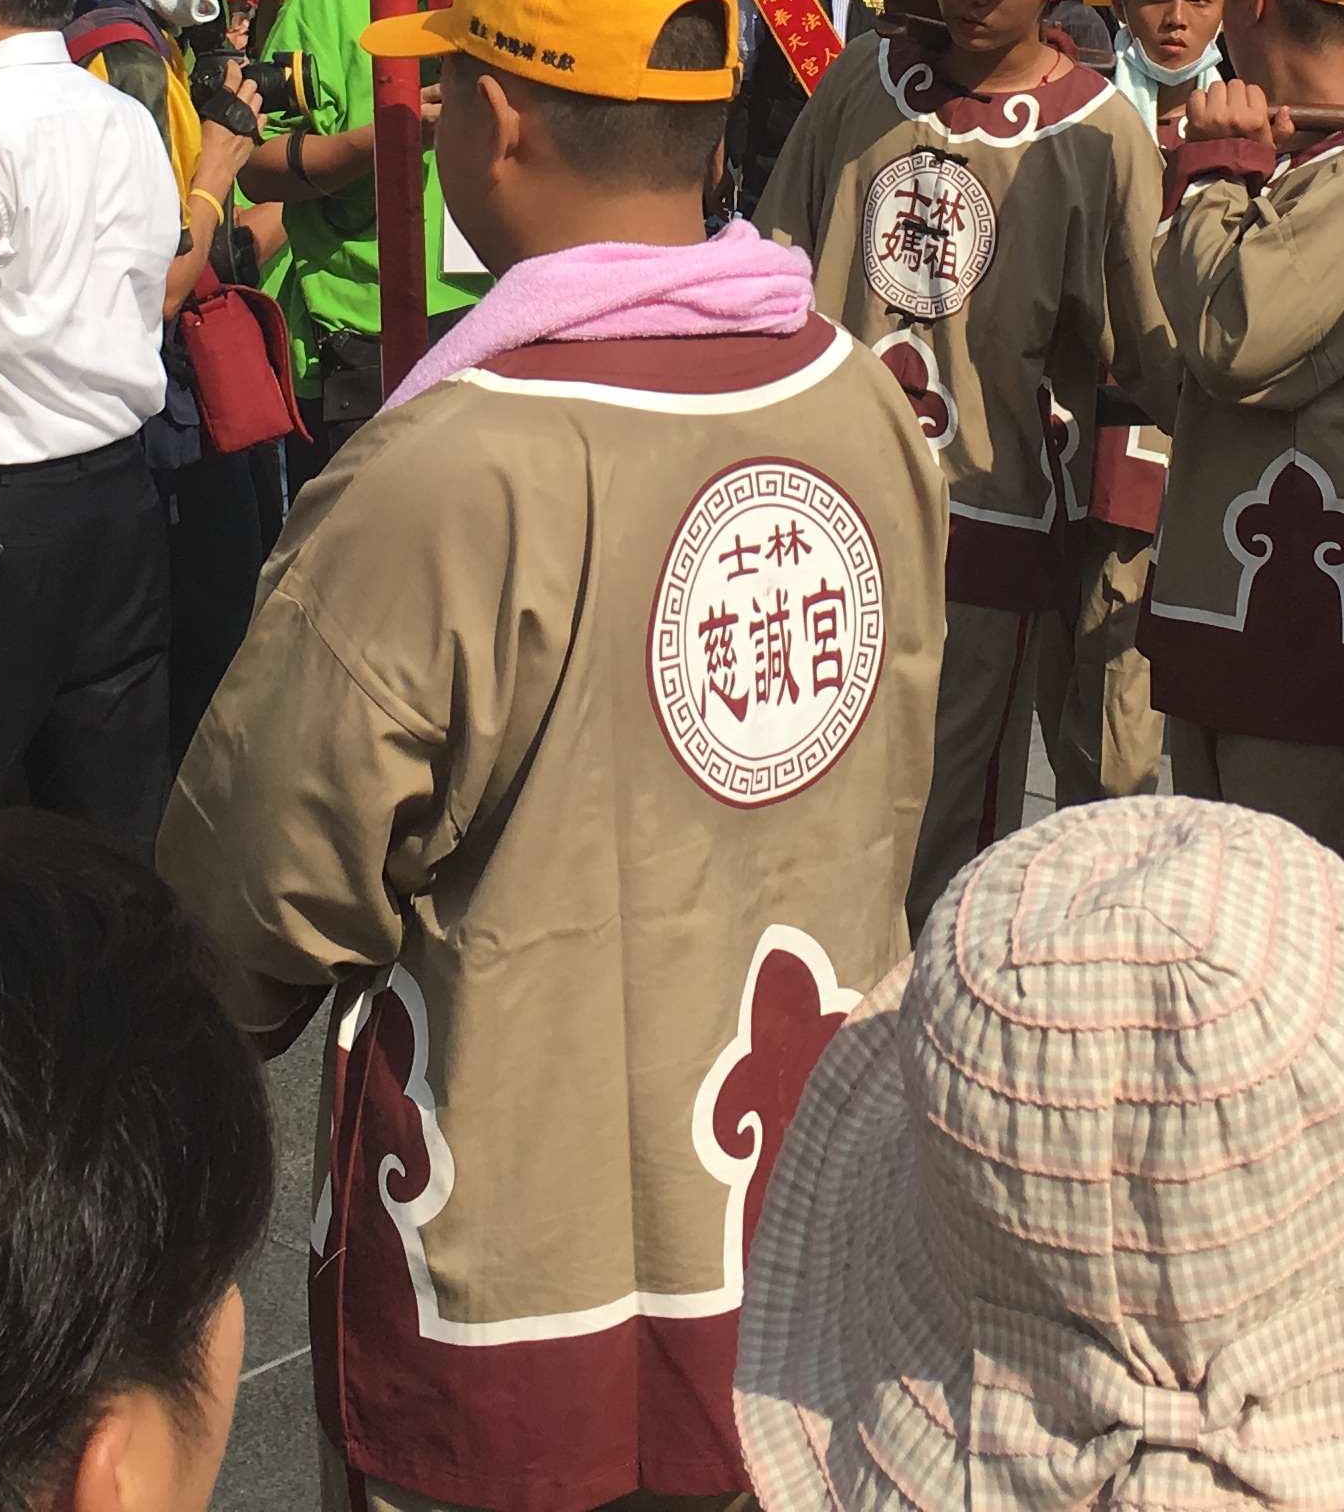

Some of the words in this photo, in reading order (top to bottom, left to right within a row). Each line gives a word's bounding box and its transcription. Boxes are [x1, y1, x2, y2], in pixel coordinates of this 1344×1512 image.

[894, 178, 966, 237] 士林
[878, 221, 960, 287] 媽祖
[718, 519, 814, 582] 士林
